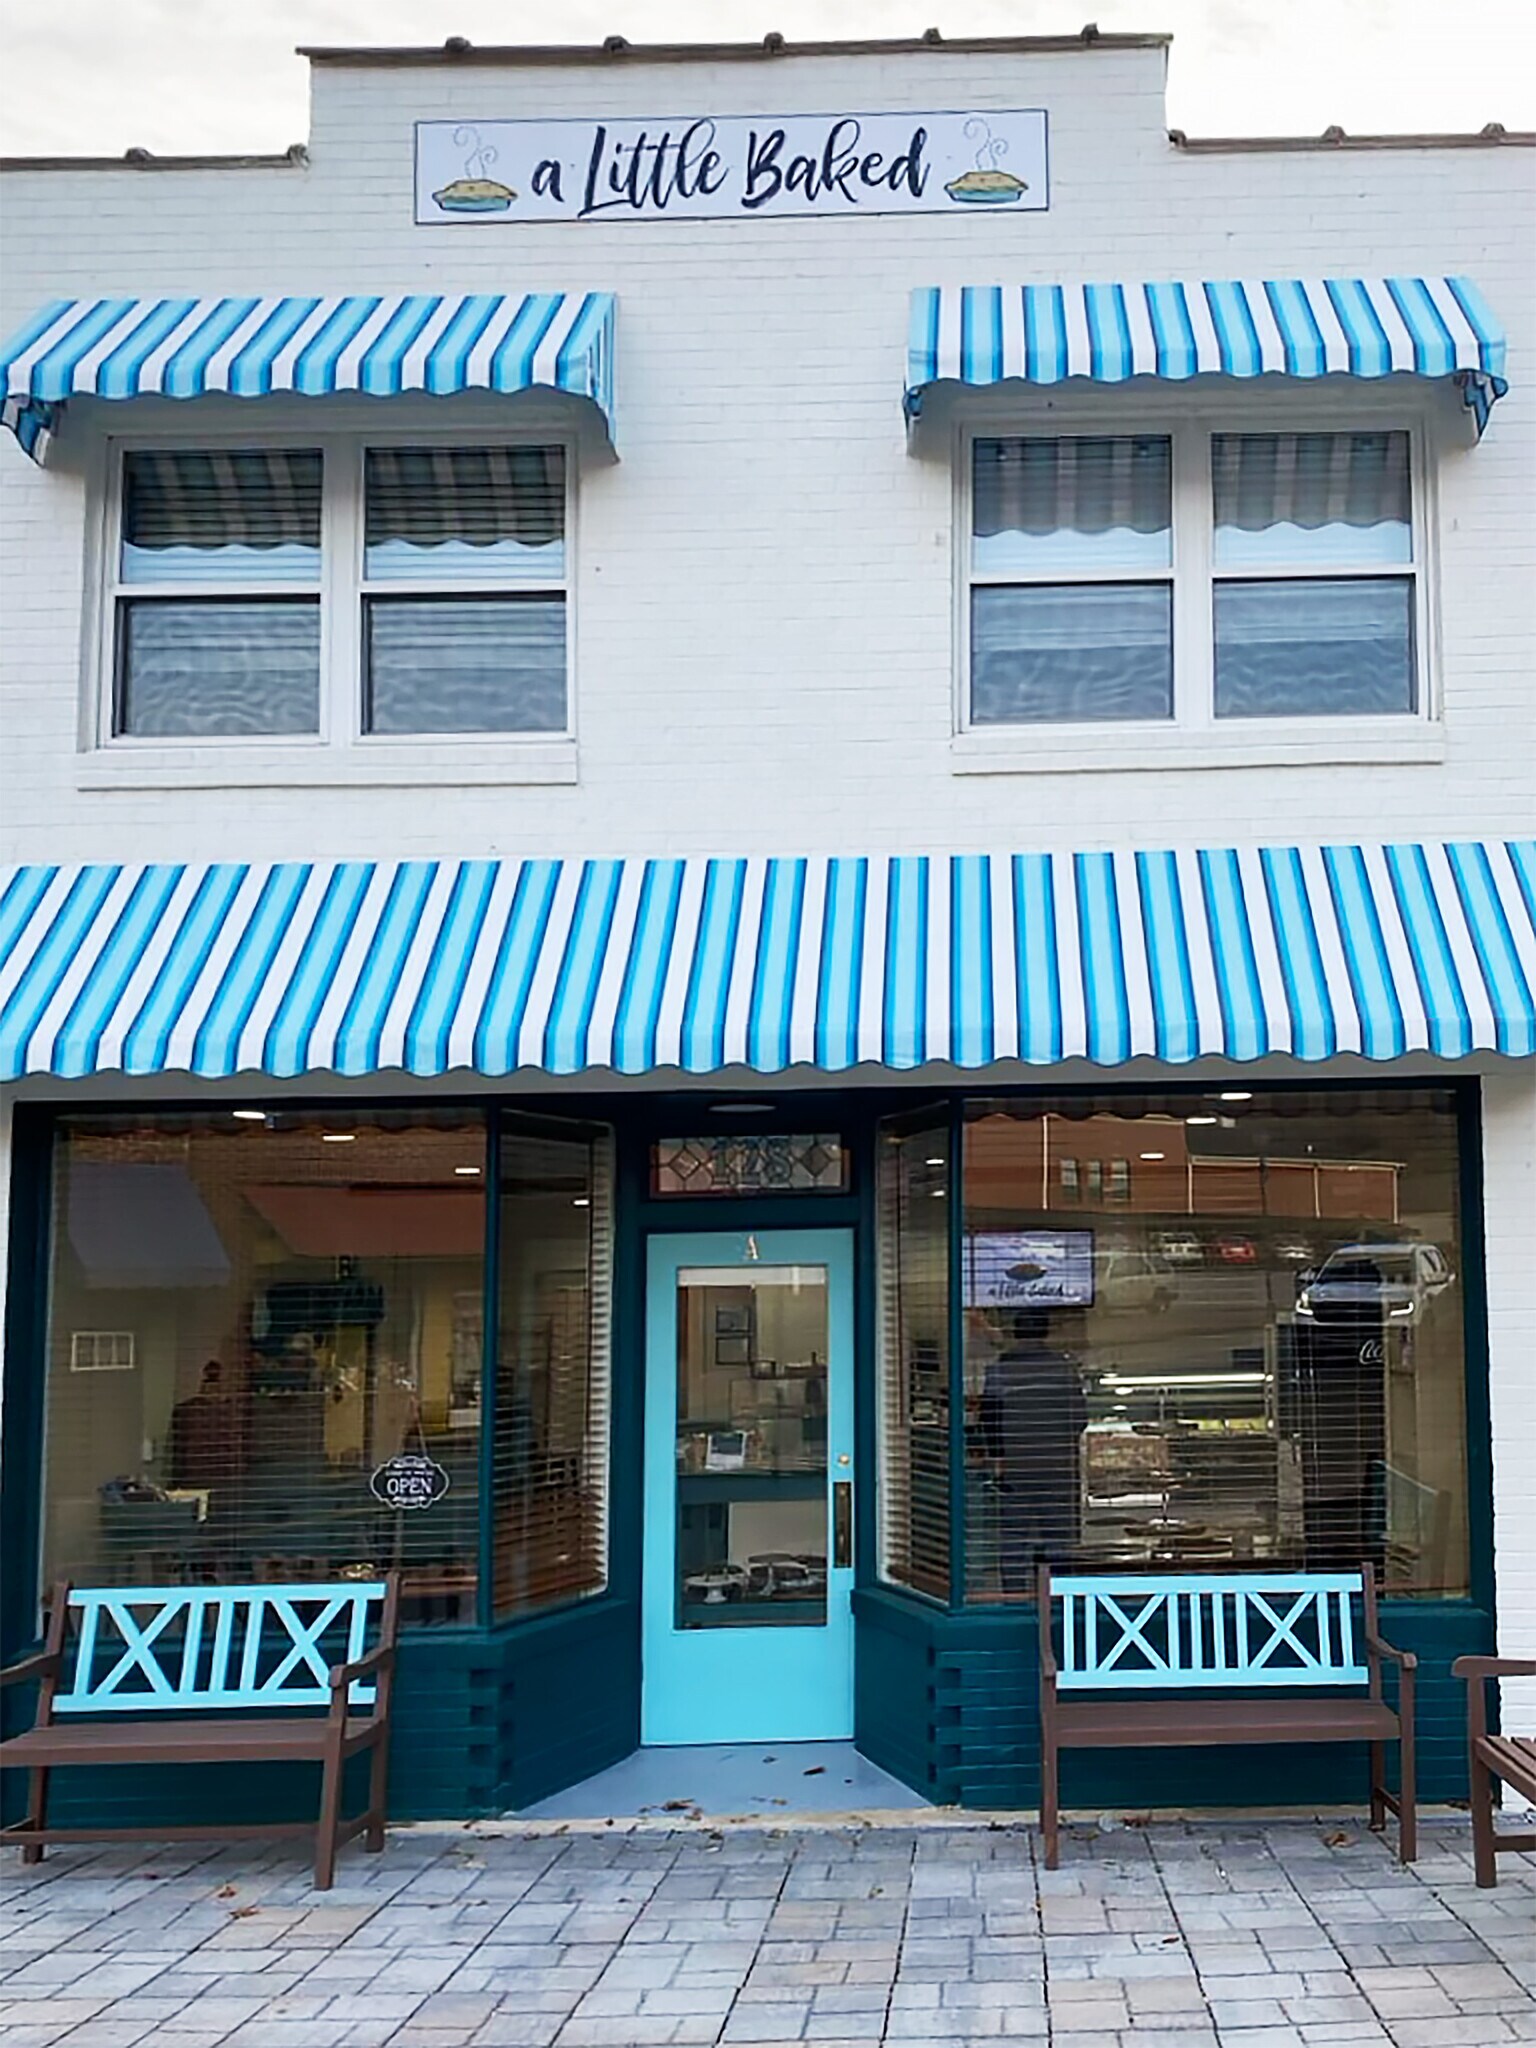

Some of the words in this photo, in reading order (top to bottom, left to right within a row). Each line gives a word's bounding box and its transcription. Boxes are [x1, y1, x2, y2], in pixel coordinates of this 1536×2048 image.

[531, 159, 565, 203] a
[577, 117, 730, 219] Little
[740, 118, 931, 209] Baked
[387, 1477, 433, 1495] OPEN
